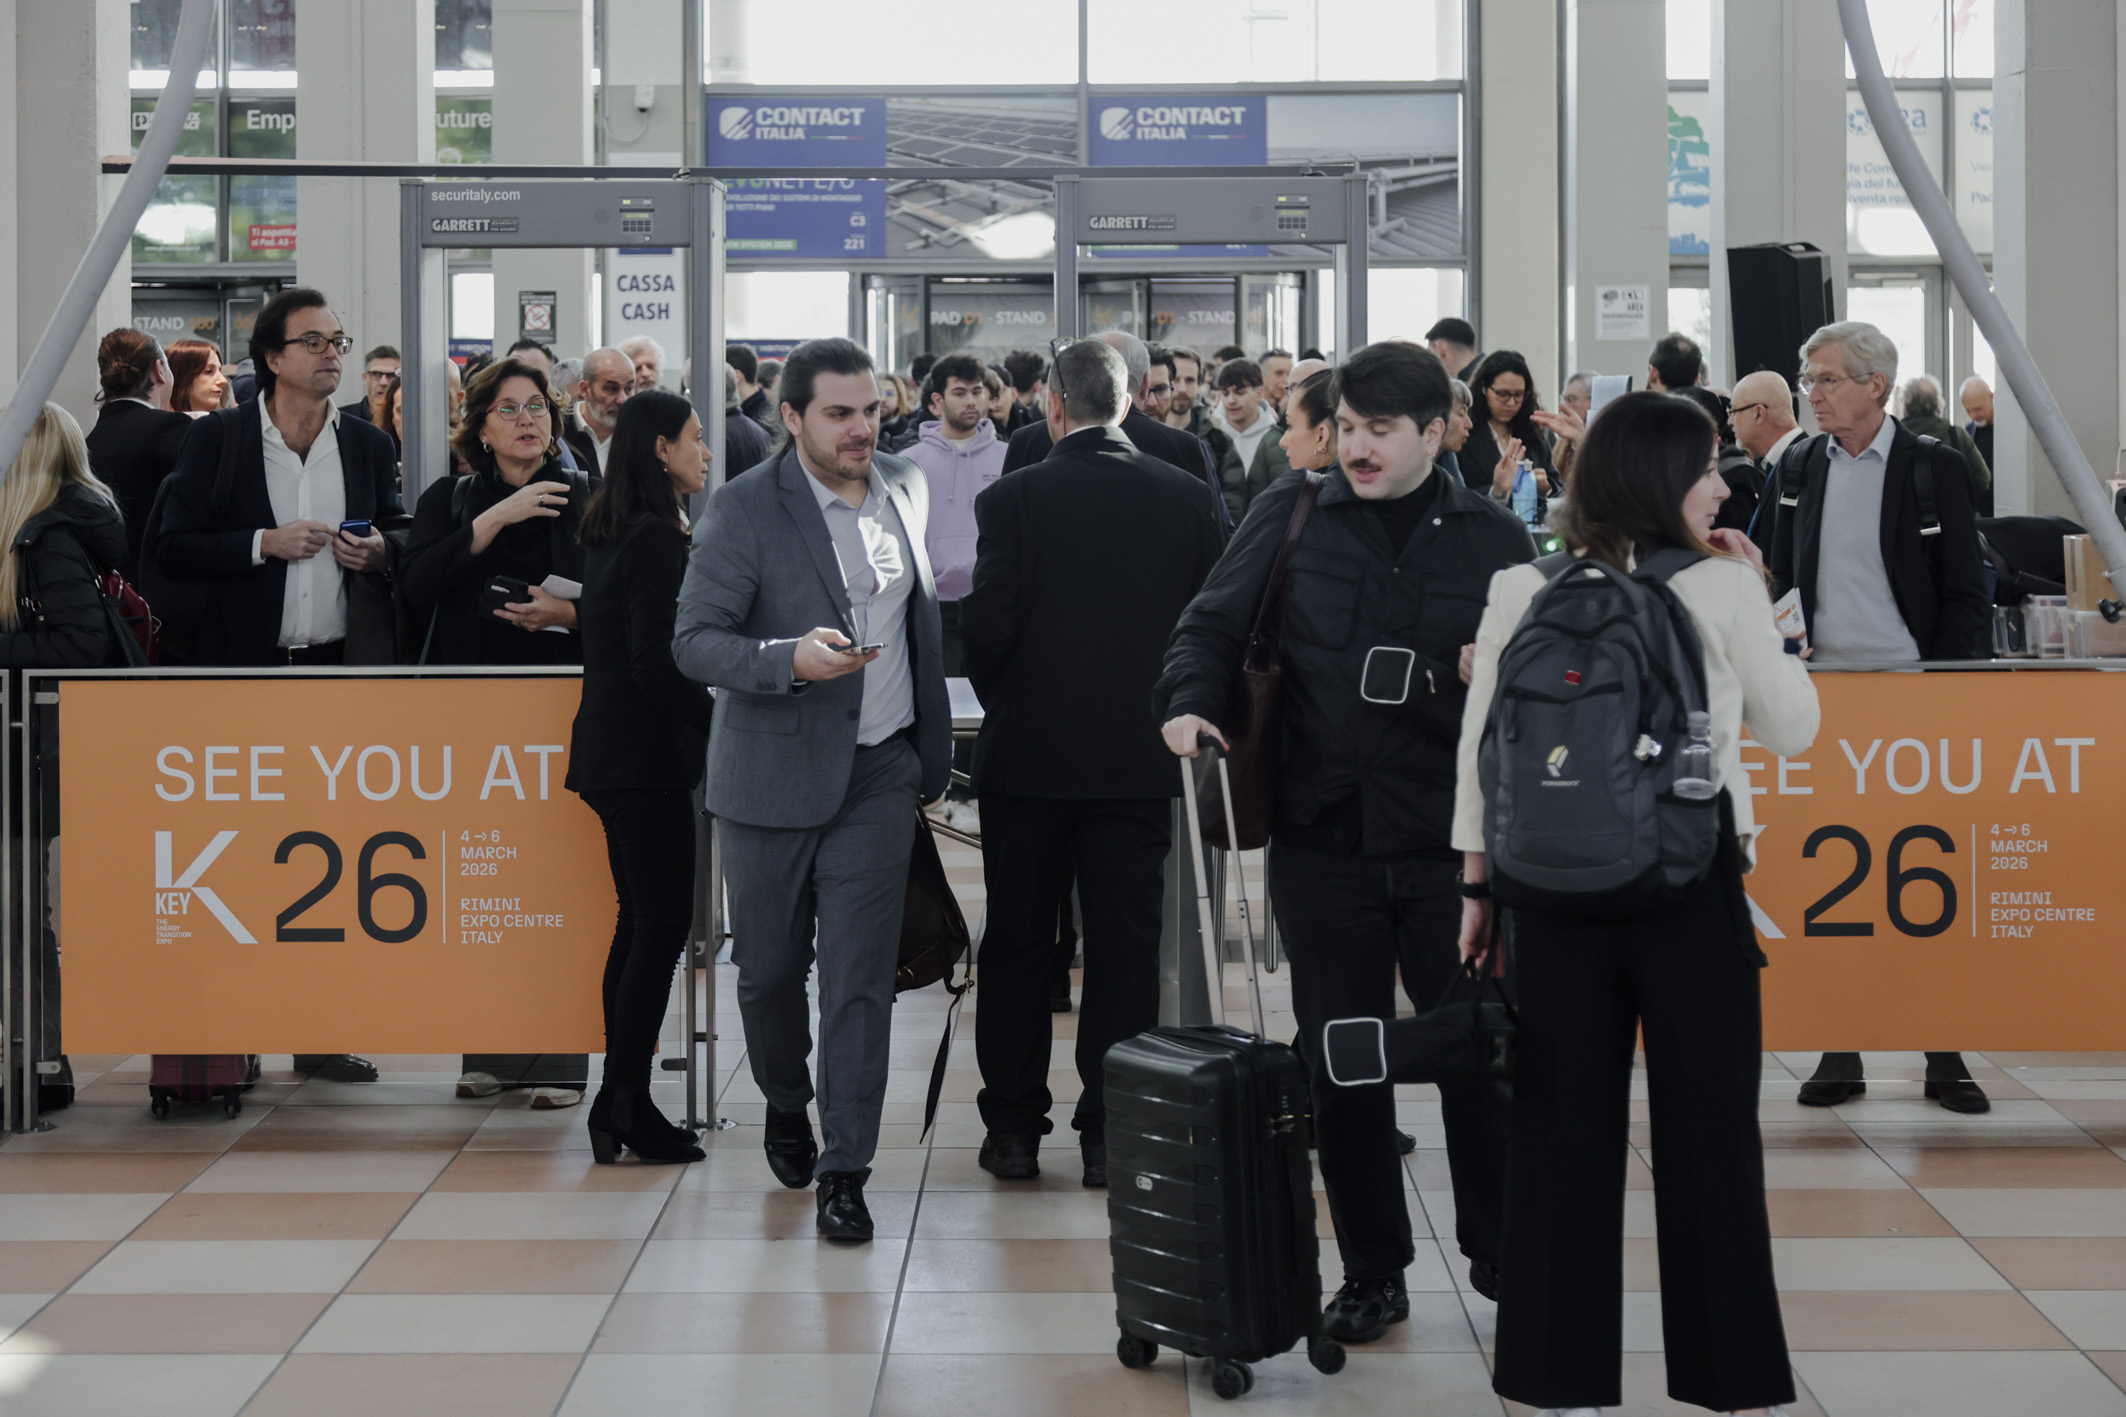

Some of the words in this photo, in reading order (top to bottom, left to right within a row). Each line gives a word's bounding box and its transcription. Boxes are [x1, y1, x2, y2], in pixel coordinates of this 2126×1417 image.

[436, 109, 491, 128] uture
[755, 107, 865, 126] CONTACT
[1136, 106, 1247, 126] CONTACT
[755, 126, 806, 140] ITALIA
[1136, 126, 1187, 140] ITALIA
[431, 188, 520, 204] securitaly.com
[432, 219, 490, 232] GARRETT
[1089, 216, 1148, 229] GARRETT
[617, 274, 675, 292] CASSA
[622, 303, 669, 320] CASH
[931, 311, 961, 326] PAD
[963, 311, 982, 325] D1
[995, 310, 1046, 326] STAND
[1188, 310, 1235, 325] STAND
[133, 316, 184, 330] STAND
[154, 745, 285, 802] SEE
[309, 745, 453, 802] YOU
[479, 744, 564, 801] AT
[1838, 738, 1982, 795] YOU
[2009, 738, 2096, 794] AT
[461, 846, 517, 859] MARCH
[1991, 840, 2048, 853] MARCH
[461, 862, 498, 876] 2026
[1990, 856, 2028, 870] 2026
[273, 830, 428, 944] 26
[1802, 824, 1957, 938] 26
[155, 892, 191, 915] KEY
[461, 898, 521, 911] RIMINI
[1991, 891, 2052, 905] RIMINI
[461, 914, 500, 927] EXPO
[503, 914, 564, 927] CENTRE
[1991, 908, 2031, 921] EXPO
[2034, 908, 2096, 921] CENTRE
[461, 931, 503, 944] ITALY
[1991, 925, 2034, 938] ITALY
